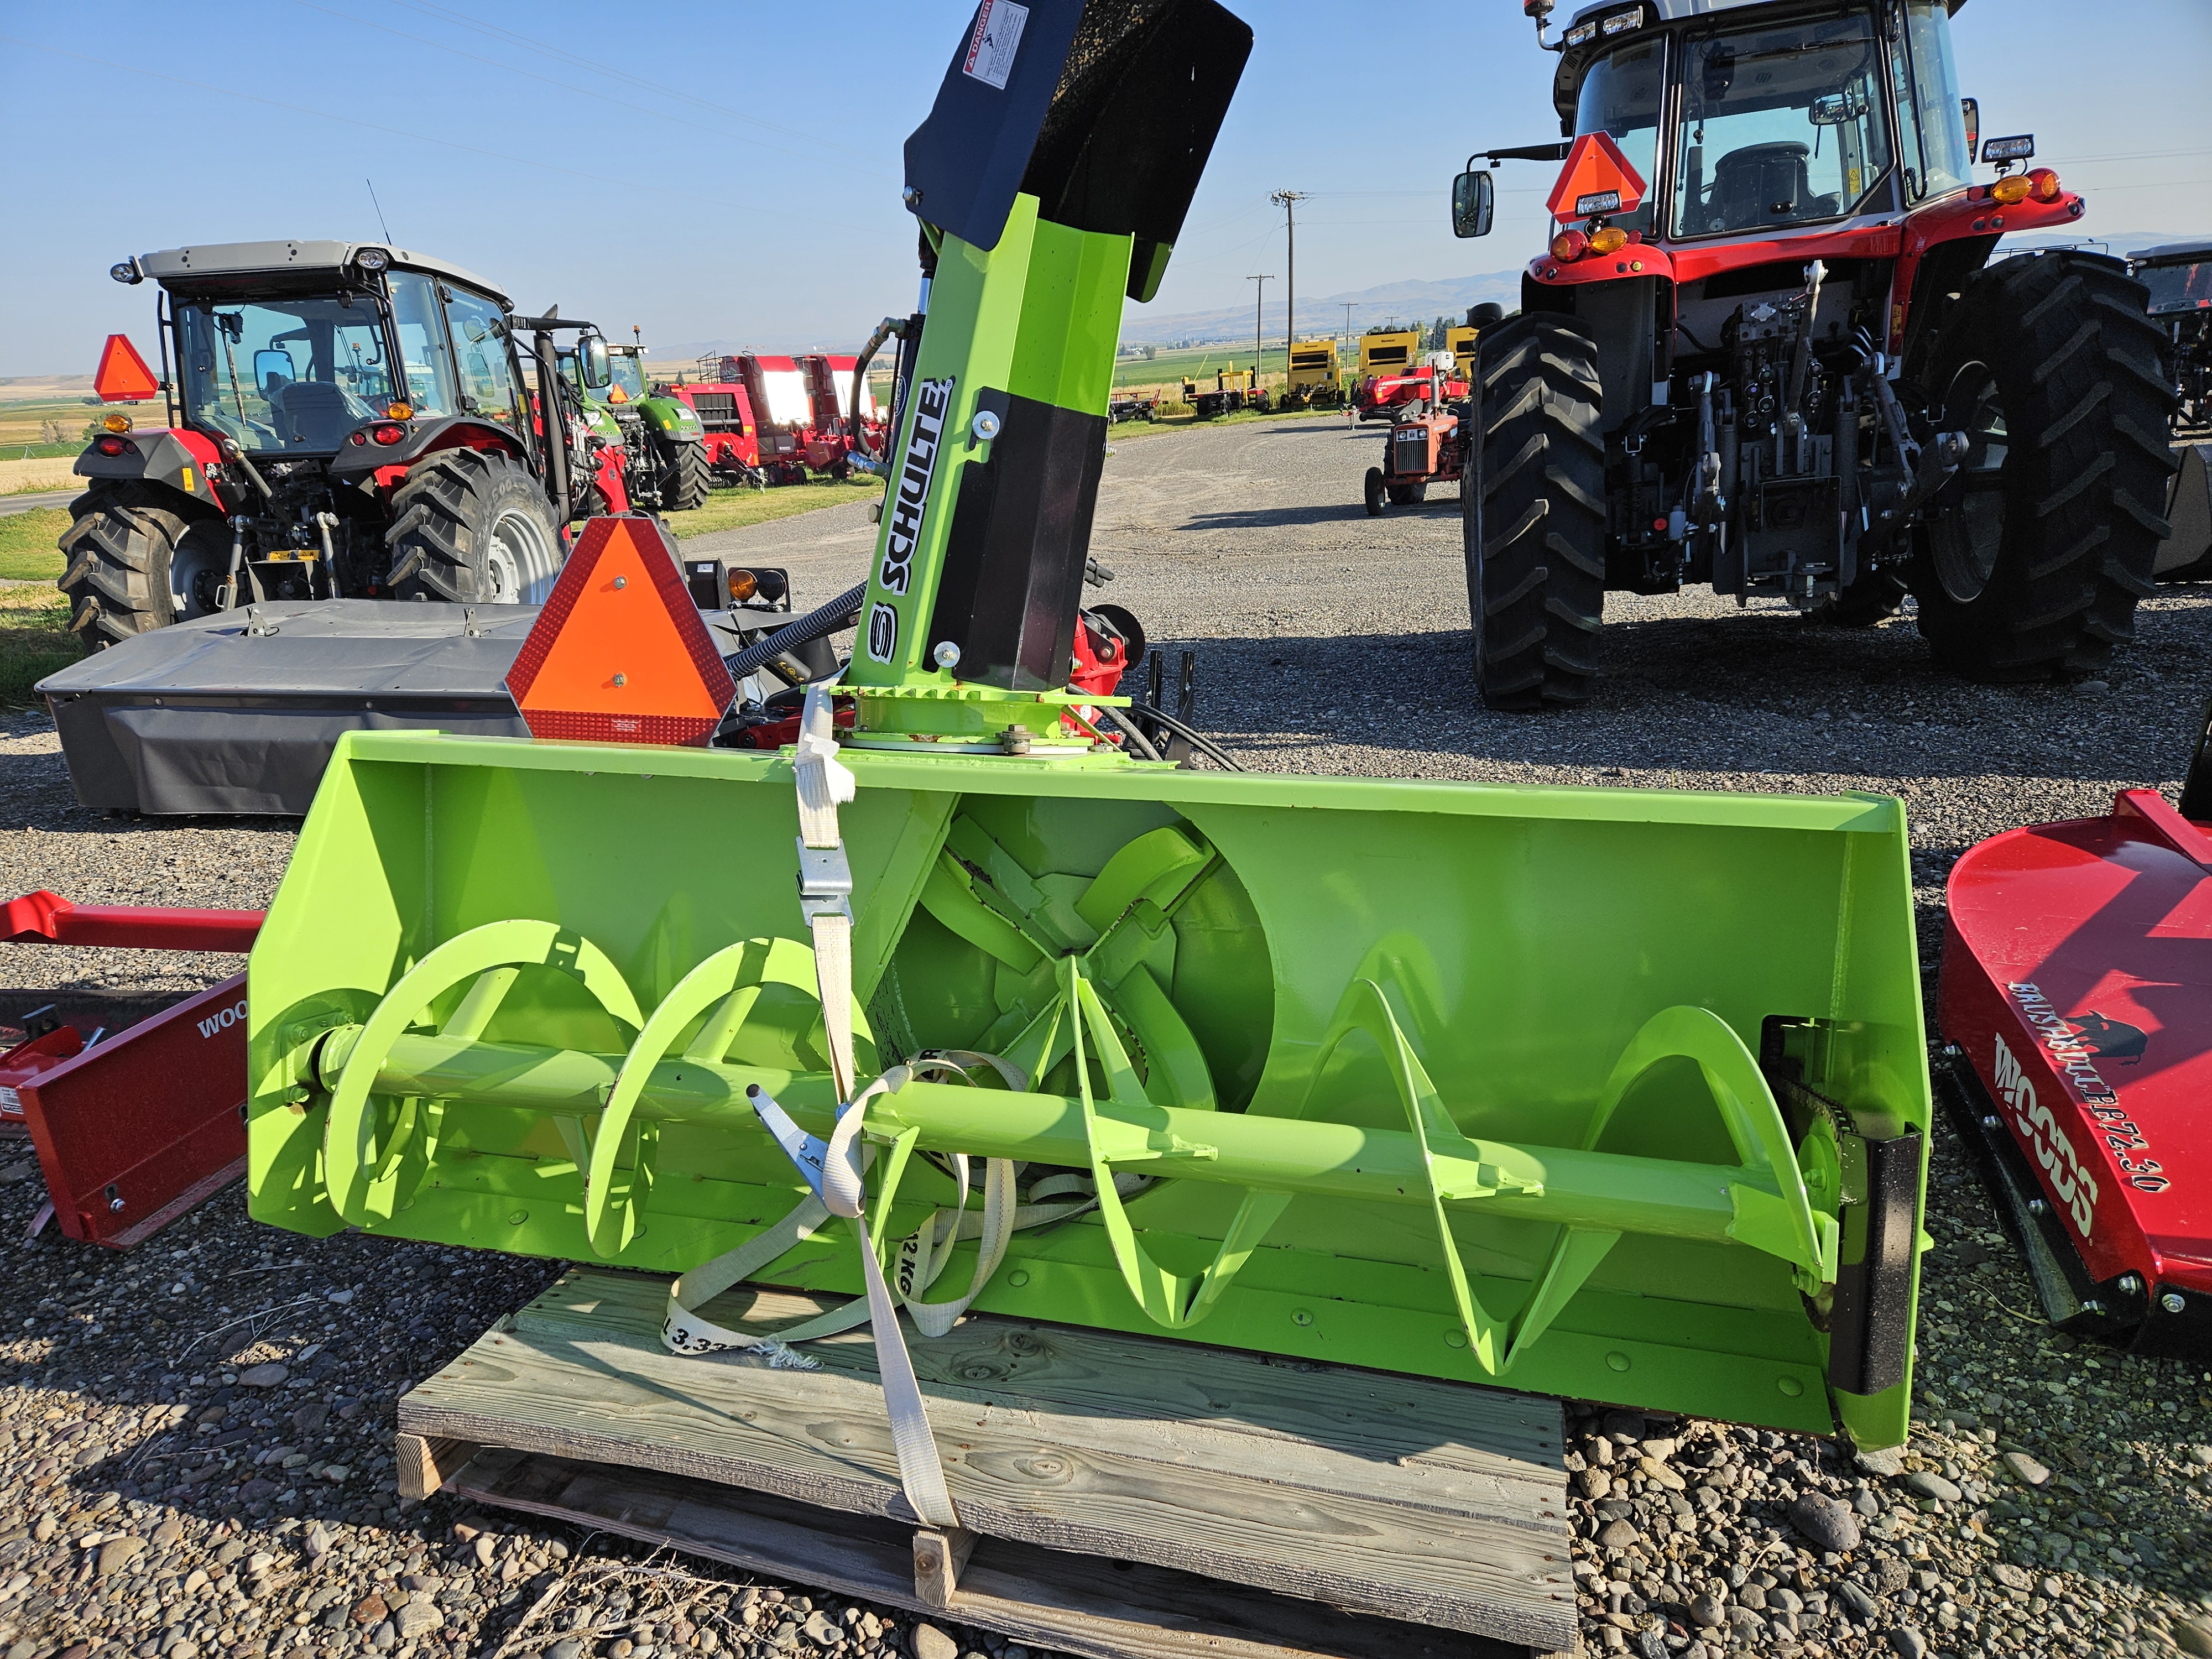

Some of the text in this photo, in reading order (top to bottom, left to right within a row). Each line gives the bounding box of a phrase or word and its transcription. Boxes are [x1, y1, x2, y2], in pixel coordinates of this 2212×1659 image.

[972, 1, 992, 53] DANGER
[881, 385, 946, 592] SCHULTE
[196, 999, 249, 1039] WOO
[1995, 1032, 2098, 1238] WOODS
[900, 1258, 916, 1296] KG
